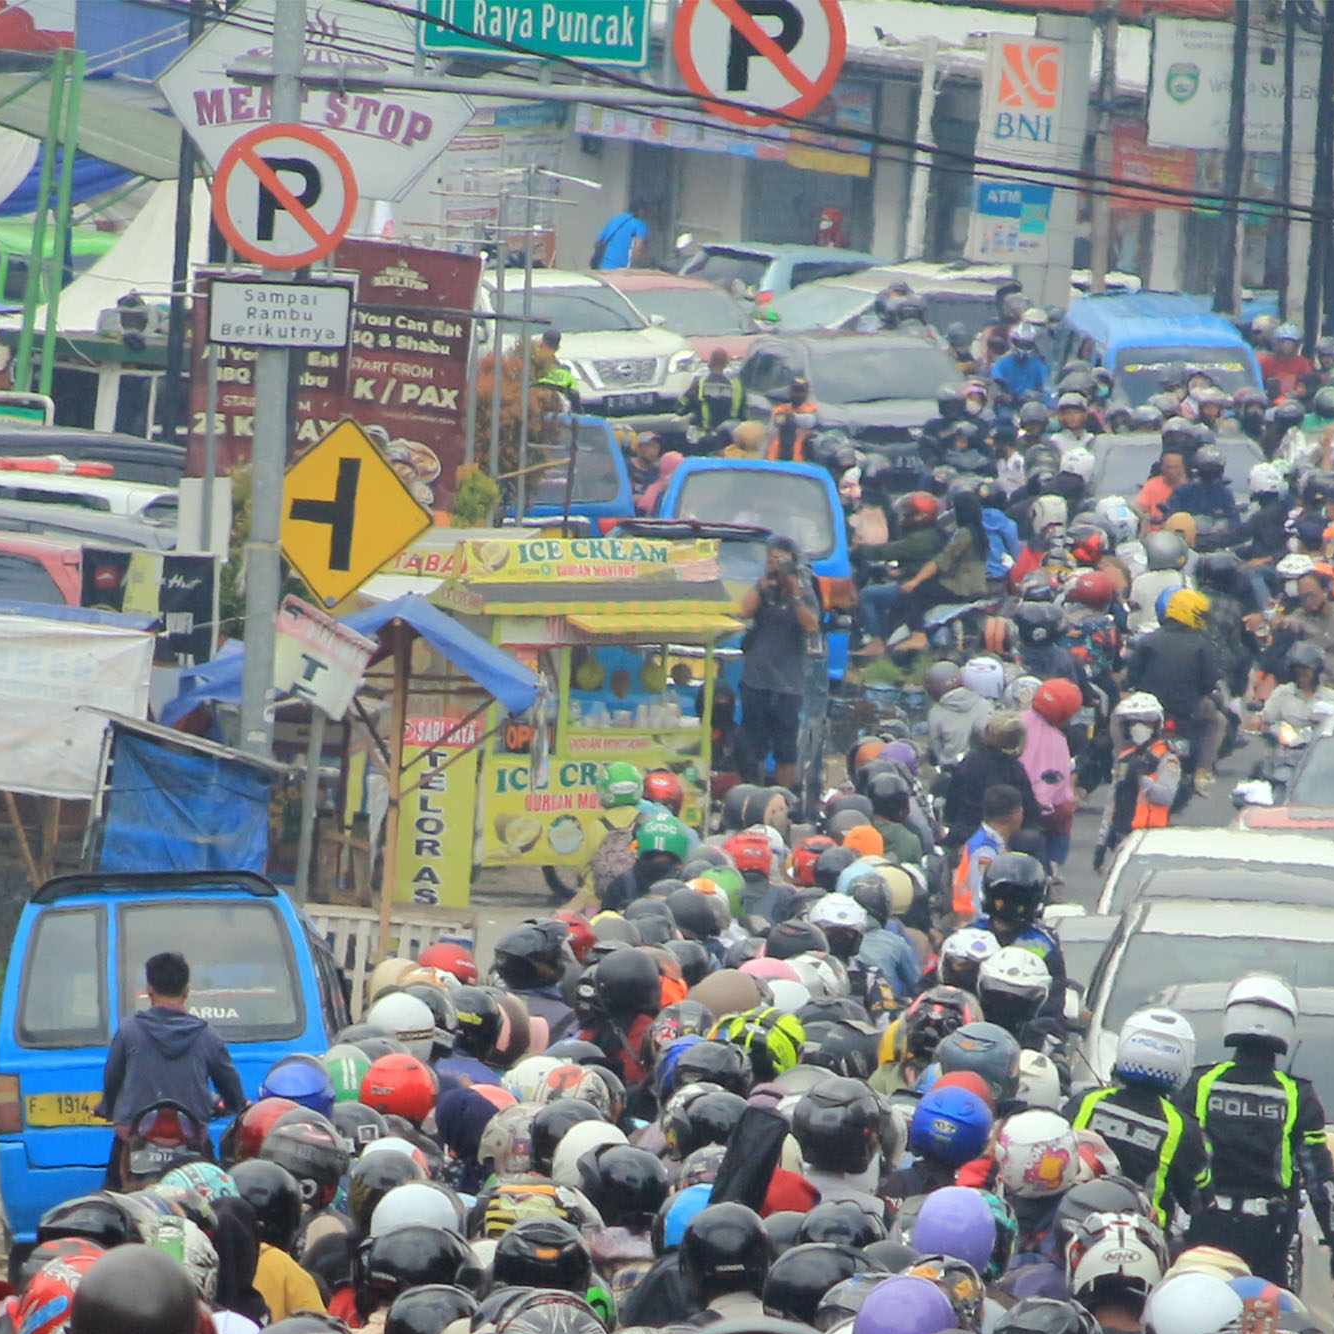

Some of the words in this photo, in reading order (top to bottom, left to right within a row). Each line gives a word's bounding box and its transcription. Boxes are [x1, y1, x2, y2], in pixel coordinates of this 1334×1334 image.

[473, 0, 533, 42] Raya
[542, 3, 635, 46] Puncak
[193, 86, 309, 127] ME
[325, 91, 434, 147] STOP
[995, 112, 1052, 142] BNI
[244, 289, 319, 305] Sampai
[246, 306, 314, 322] Rambu
[359, 311, 391, 327] You
[395, 314, 428, 333] Can
[432, 319, 463, 338] Eat
[220, 322, 336, 341] Berikutnya
[395, 334, 451, 355] Shabu
[391, 361, 435, 378] FROM
[400, 382, 460, 410] PAX
[518, 539, 564, 564] ICE
[569, 539, 668, 564] CREAM
[417, 720, 445, 745] SARI
[56, 1096, 90, 1116] 1914
[1208, 1096, 1286, 1121] POLISI
